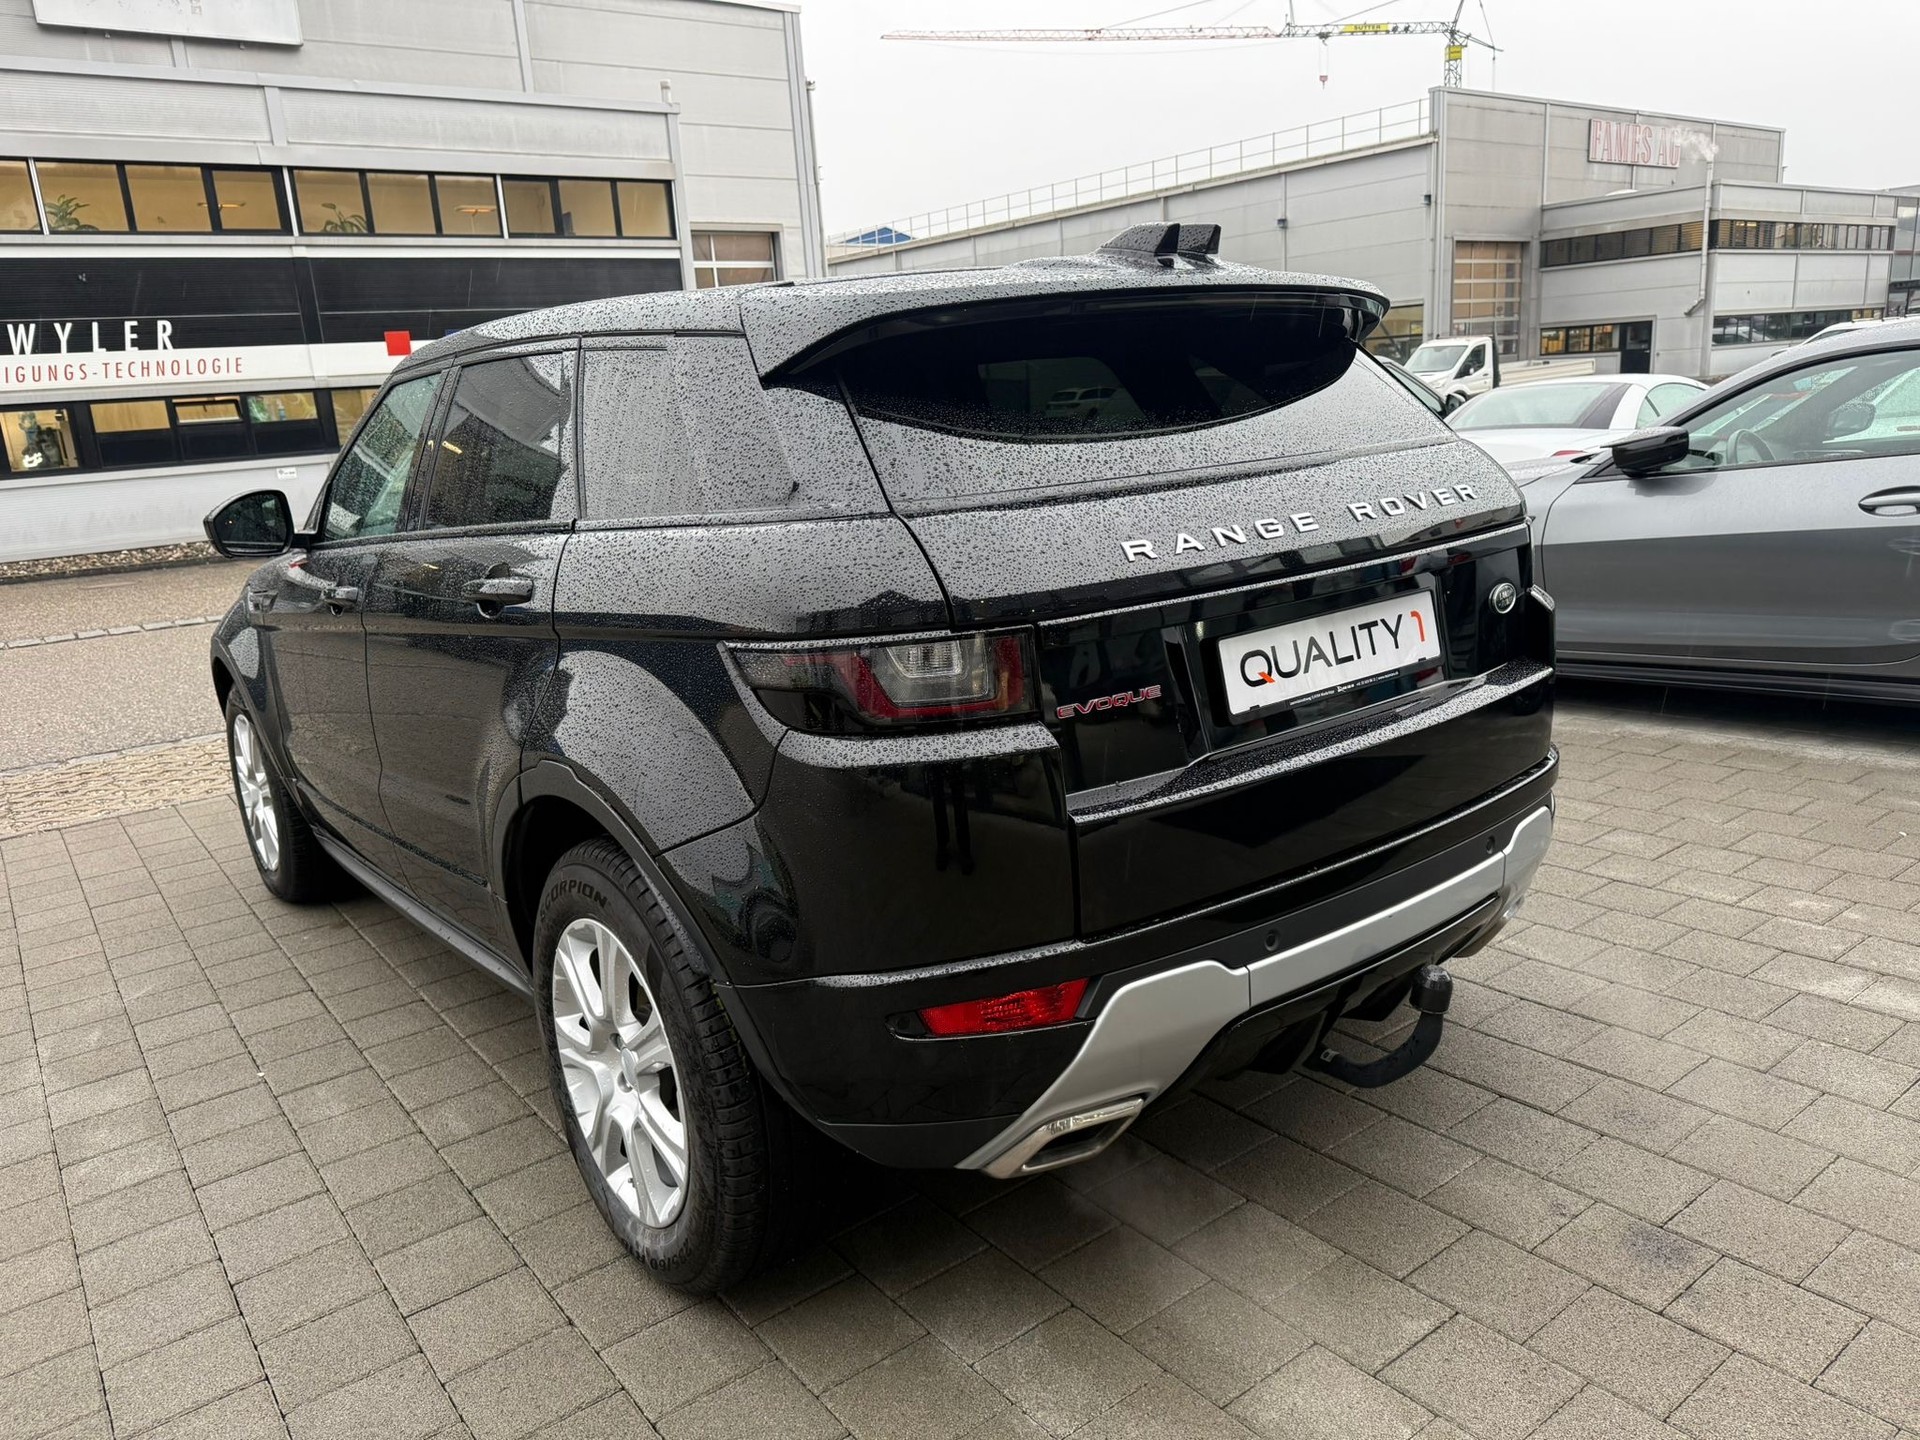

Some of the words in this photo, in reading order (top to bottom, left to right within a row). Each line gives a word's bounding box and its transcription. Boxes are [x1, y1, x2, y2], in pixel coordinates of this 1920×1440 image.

[1591, 120, 1653, 164] FAMES
[7, 320, 174, 354] WYLER
[5, 357, 243, 384] IGUNGS-TECHNOLOGIE
[1120, 511, 1320, 562] RANGE
[1347, 484, 1478, 522] ROVER
[1240, 613, 1403, 687] QUALITY
[1410, 610, 1426, 642] 1
[1057, 684, 1162, 719] EVOQUE
